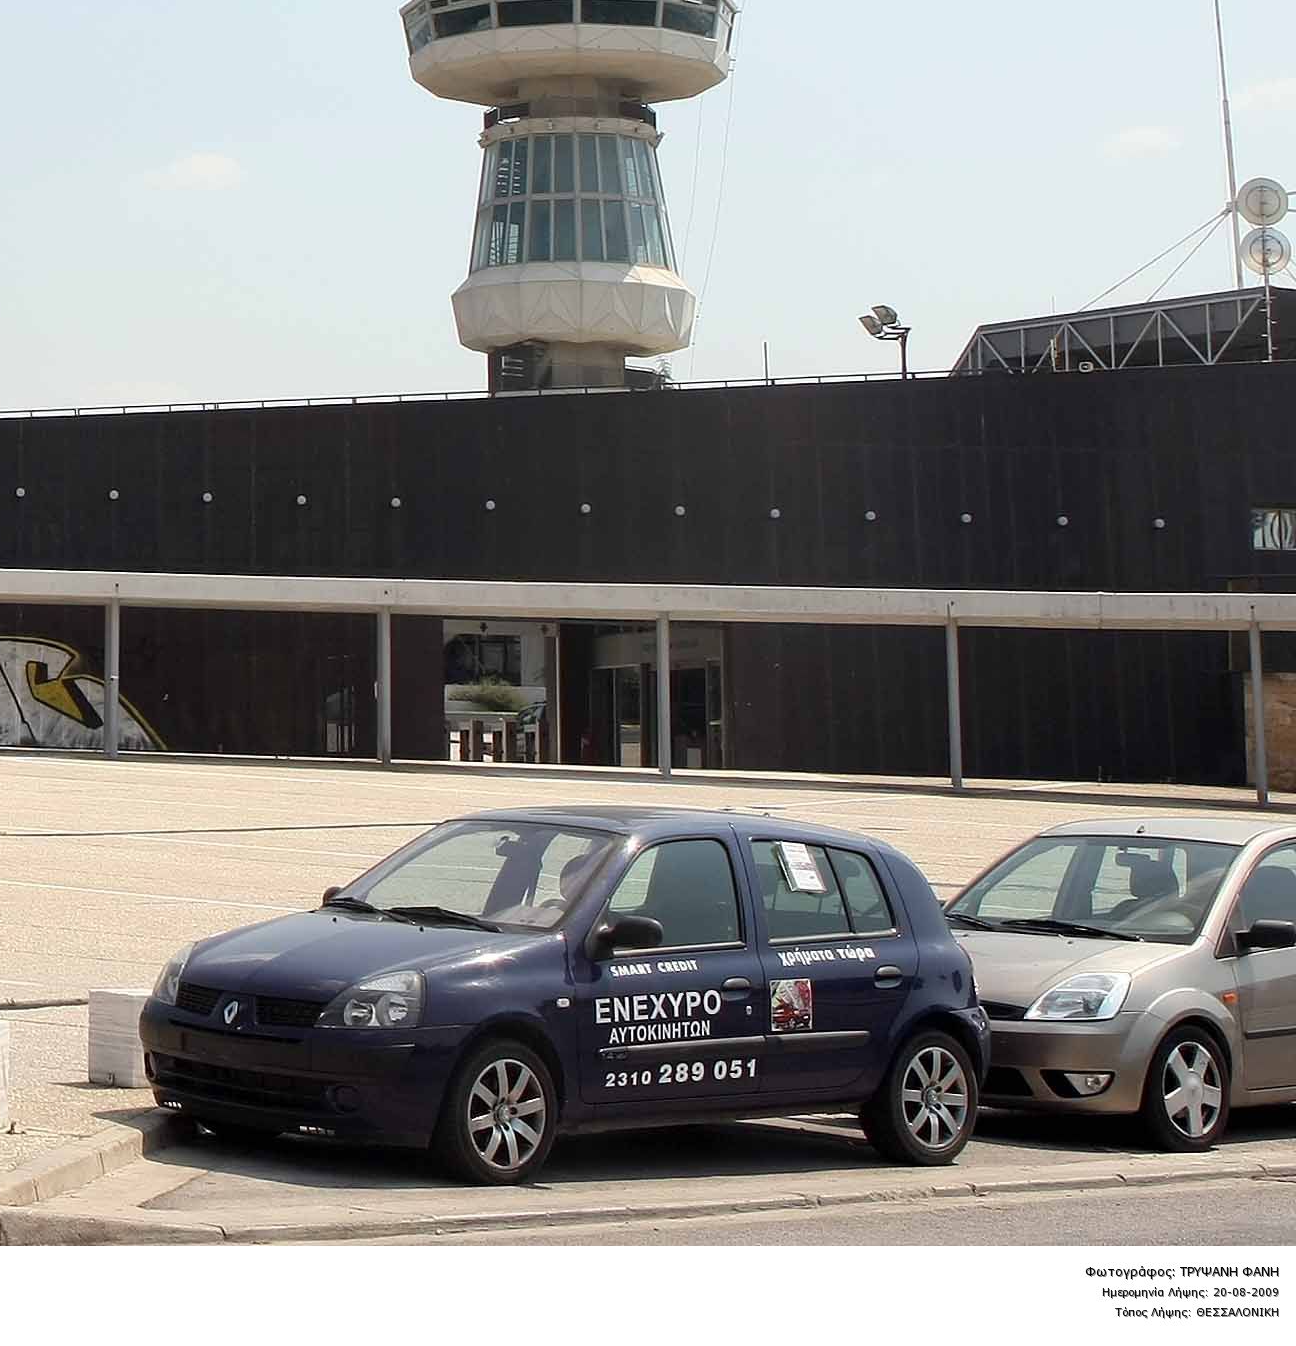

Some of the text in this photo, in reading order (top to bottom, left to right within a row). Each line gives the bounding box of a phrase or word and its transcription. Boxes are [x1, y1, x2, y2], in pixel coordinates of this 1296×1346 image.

[610, 959, 699, 978] SMART CREDIT
[778, 944, 876, 967] χρήματα τώρα
[595, 989, 722, 1024] ΕΝΕΧΥΡΟ
[609, 1019, 712, 1045] ΑΥΤΟΚΙΝΗΤΩΝ
[605, 1059, 757, 1088] 2310 289 051
